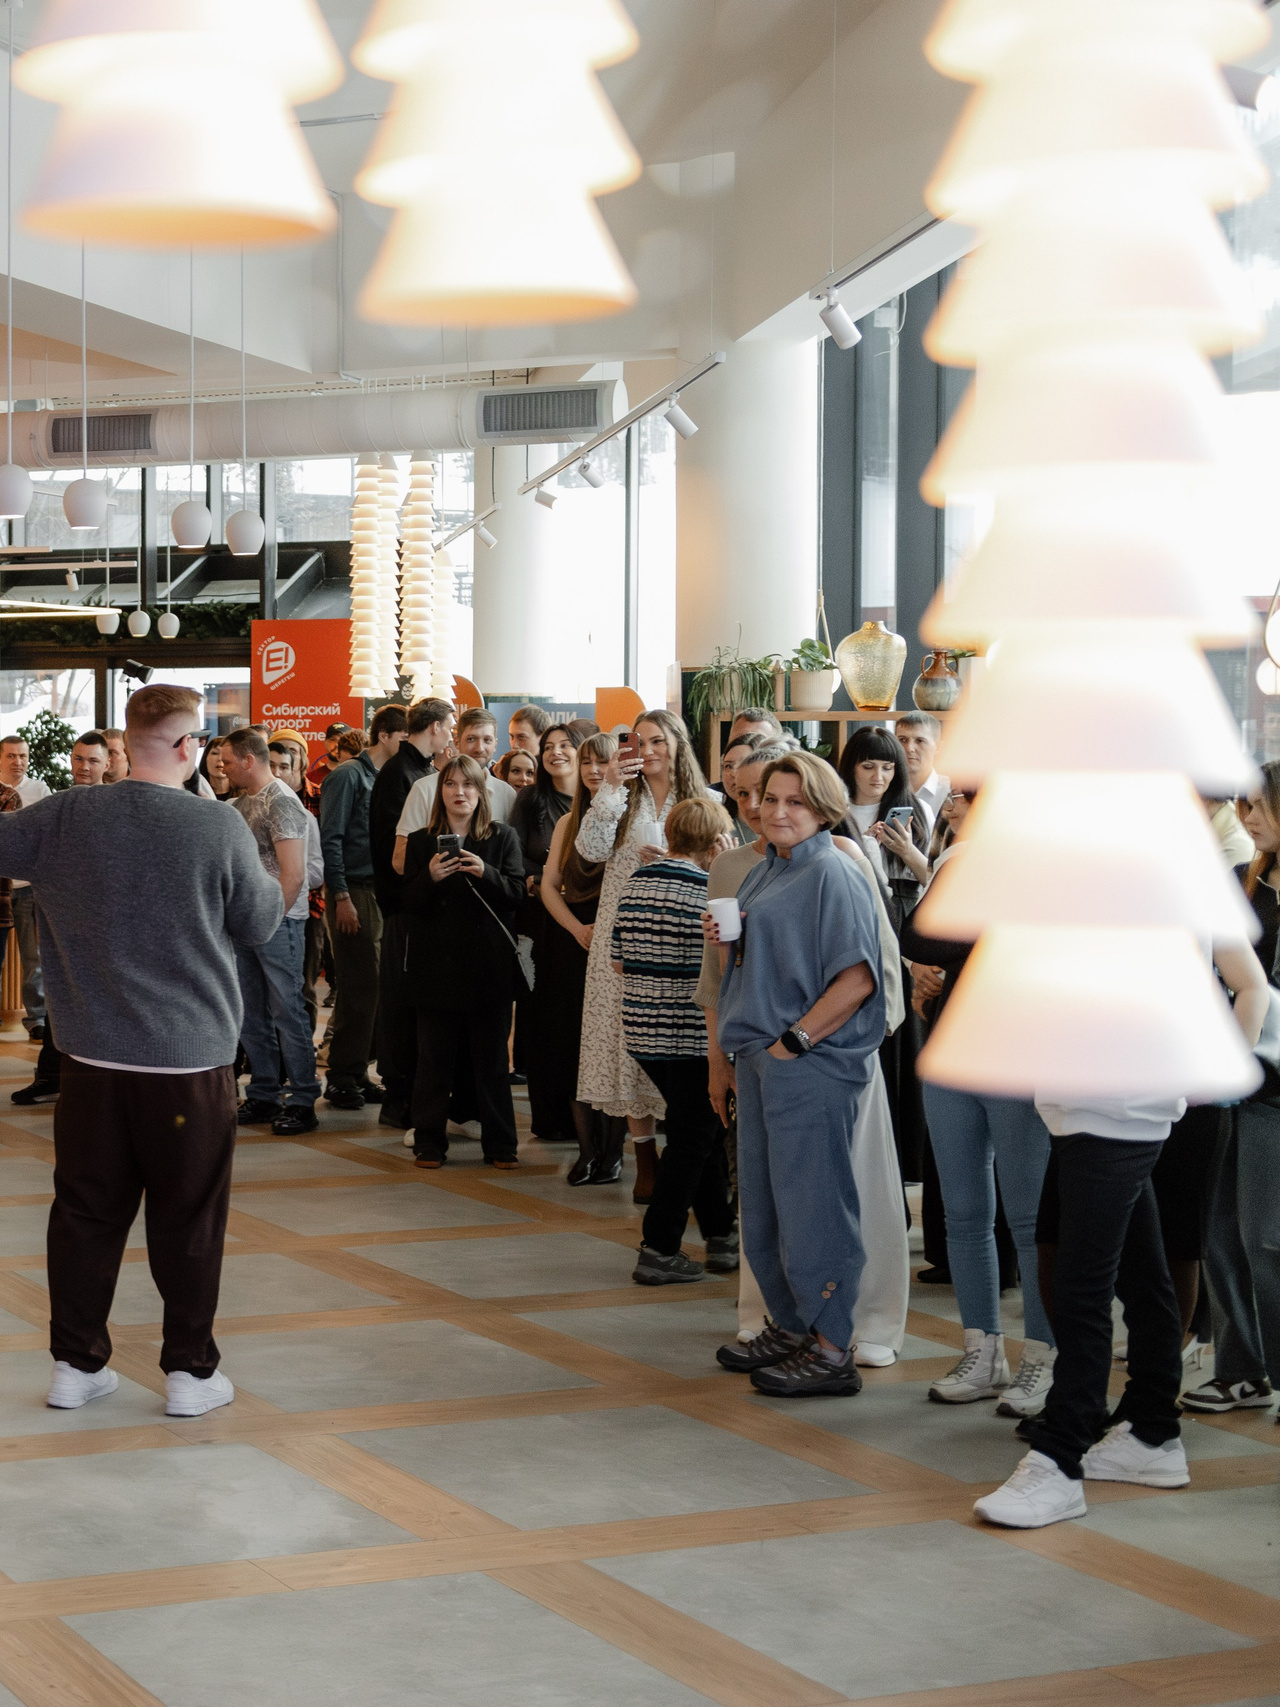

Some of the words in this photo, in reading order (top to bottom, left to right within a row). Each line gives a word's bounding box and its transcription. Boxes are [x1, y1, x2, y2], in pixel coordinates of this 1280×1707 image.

[257, 636, 276, 655] СЕКТОР
[270, 672, 296, 690] ШЕРЕГЕШ
[262, 703, 341, 718] Сибирский
[262, 719, 312, 731] курорт
